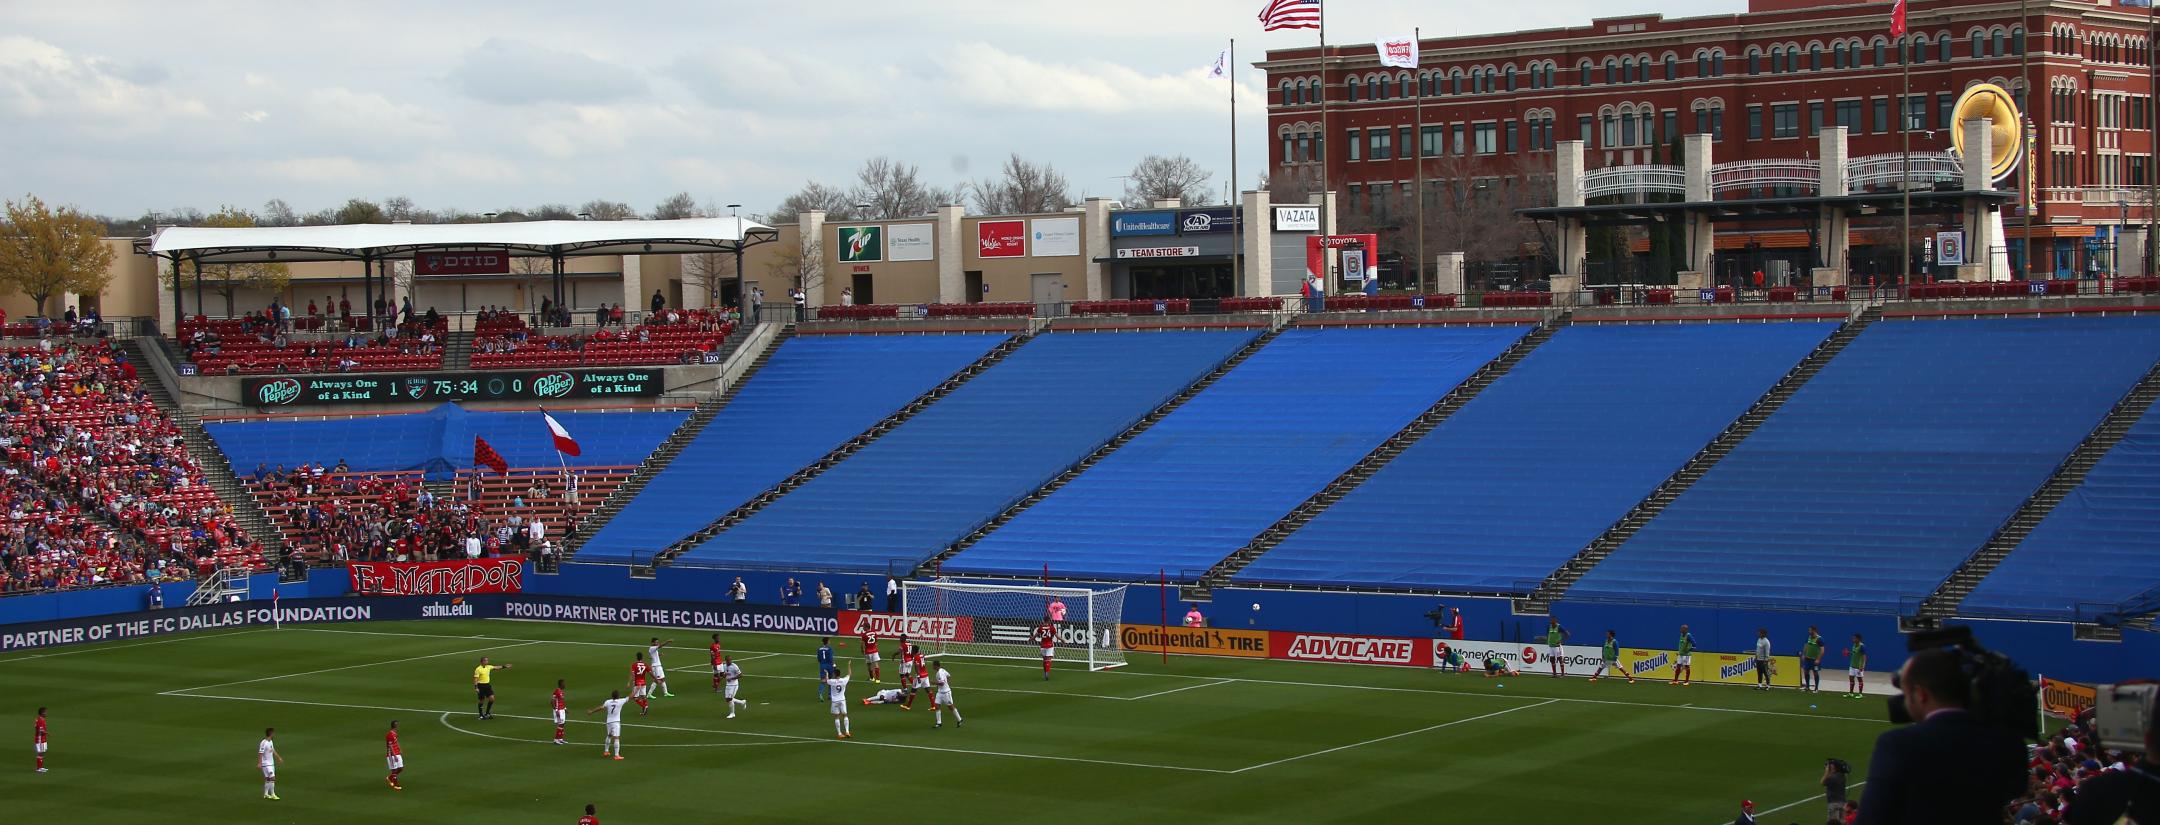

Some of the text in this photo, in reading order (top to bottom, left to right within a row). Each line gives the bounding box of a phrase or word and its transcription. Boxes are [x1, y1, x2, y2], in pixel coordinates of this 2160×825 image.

[1279, 209, 1316, 222] VAZATA
[1122, 222, 1170, 232] UnitedHealthcare
[1332, 237, 1357, 245] TOYOTA
[1131, 247, 1183, 257] TEAM STORE
[444, 255, 498, 267] DTID
[2031, 284, 2045, 292] 115
[1701, 292, 1714, 300] 116
[706, 355, 719, 363] 120
[547, 374, 562, 386] Dr
[582, 372, 649, 383] Always One
[273, 380, 289, 393] Dr
[310, 379, 378, 390] Always One
[390, 381, 398, 396] 1
[433, 380, 478, 395] 75:34
[512, 379, 522, 393] 0
[538, 377, 572, 397] Pepper
[590, 385, 602, 393] of
[614, 384, 642, 393] Kind
[263, 384, 298, 404] Pepper
[318, 391, 371, 400] of a Kind
[389, 559, 522, 595] MATADOR
[422, 601, 473, 617] snhu.edu
[506, 602, 839, 633] PROUD PARTNER OF THE FC DALLAS FOUNDATIO
[3, 605, 371, 649] PARTNER OF THE FC DALLAS FOUNDATION
[867, 634, 876, 644] 25
[1041, 629, 1051, 639] 24
[1121, 627, 1265, 651] Continental TIRE
[822, 650, 826, 660] 1
[1288, 635, 1414, 663] ADVOCARE
[1633, 652, 1669, 674] Nesquik
[1720, 655, 1758, 679] Nesquik
[636, 665, 646, 675] 37
[835, 684, 842, 693] 9
[611, 704, 616, 714] 7
